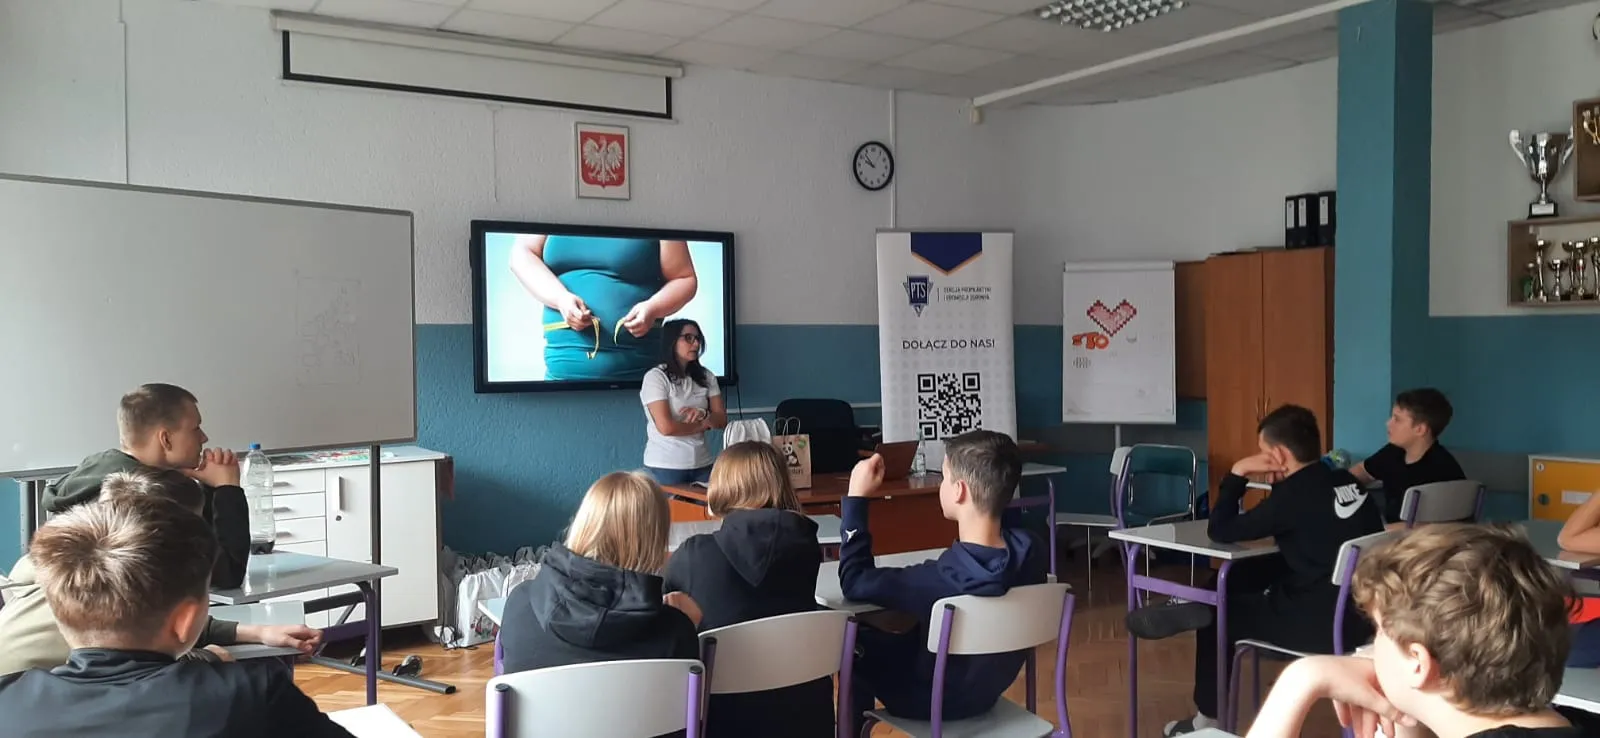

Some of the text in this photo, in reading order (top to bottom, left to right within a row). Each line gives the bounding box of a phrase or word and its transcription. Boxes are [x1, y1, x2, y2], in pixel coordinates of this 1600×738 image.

[910, 281, 926, 299] PTS
[902, 338, 995, 351] DOŁĄCZ DO NAS!
[1333, 483, 1360, 503] NIKE
